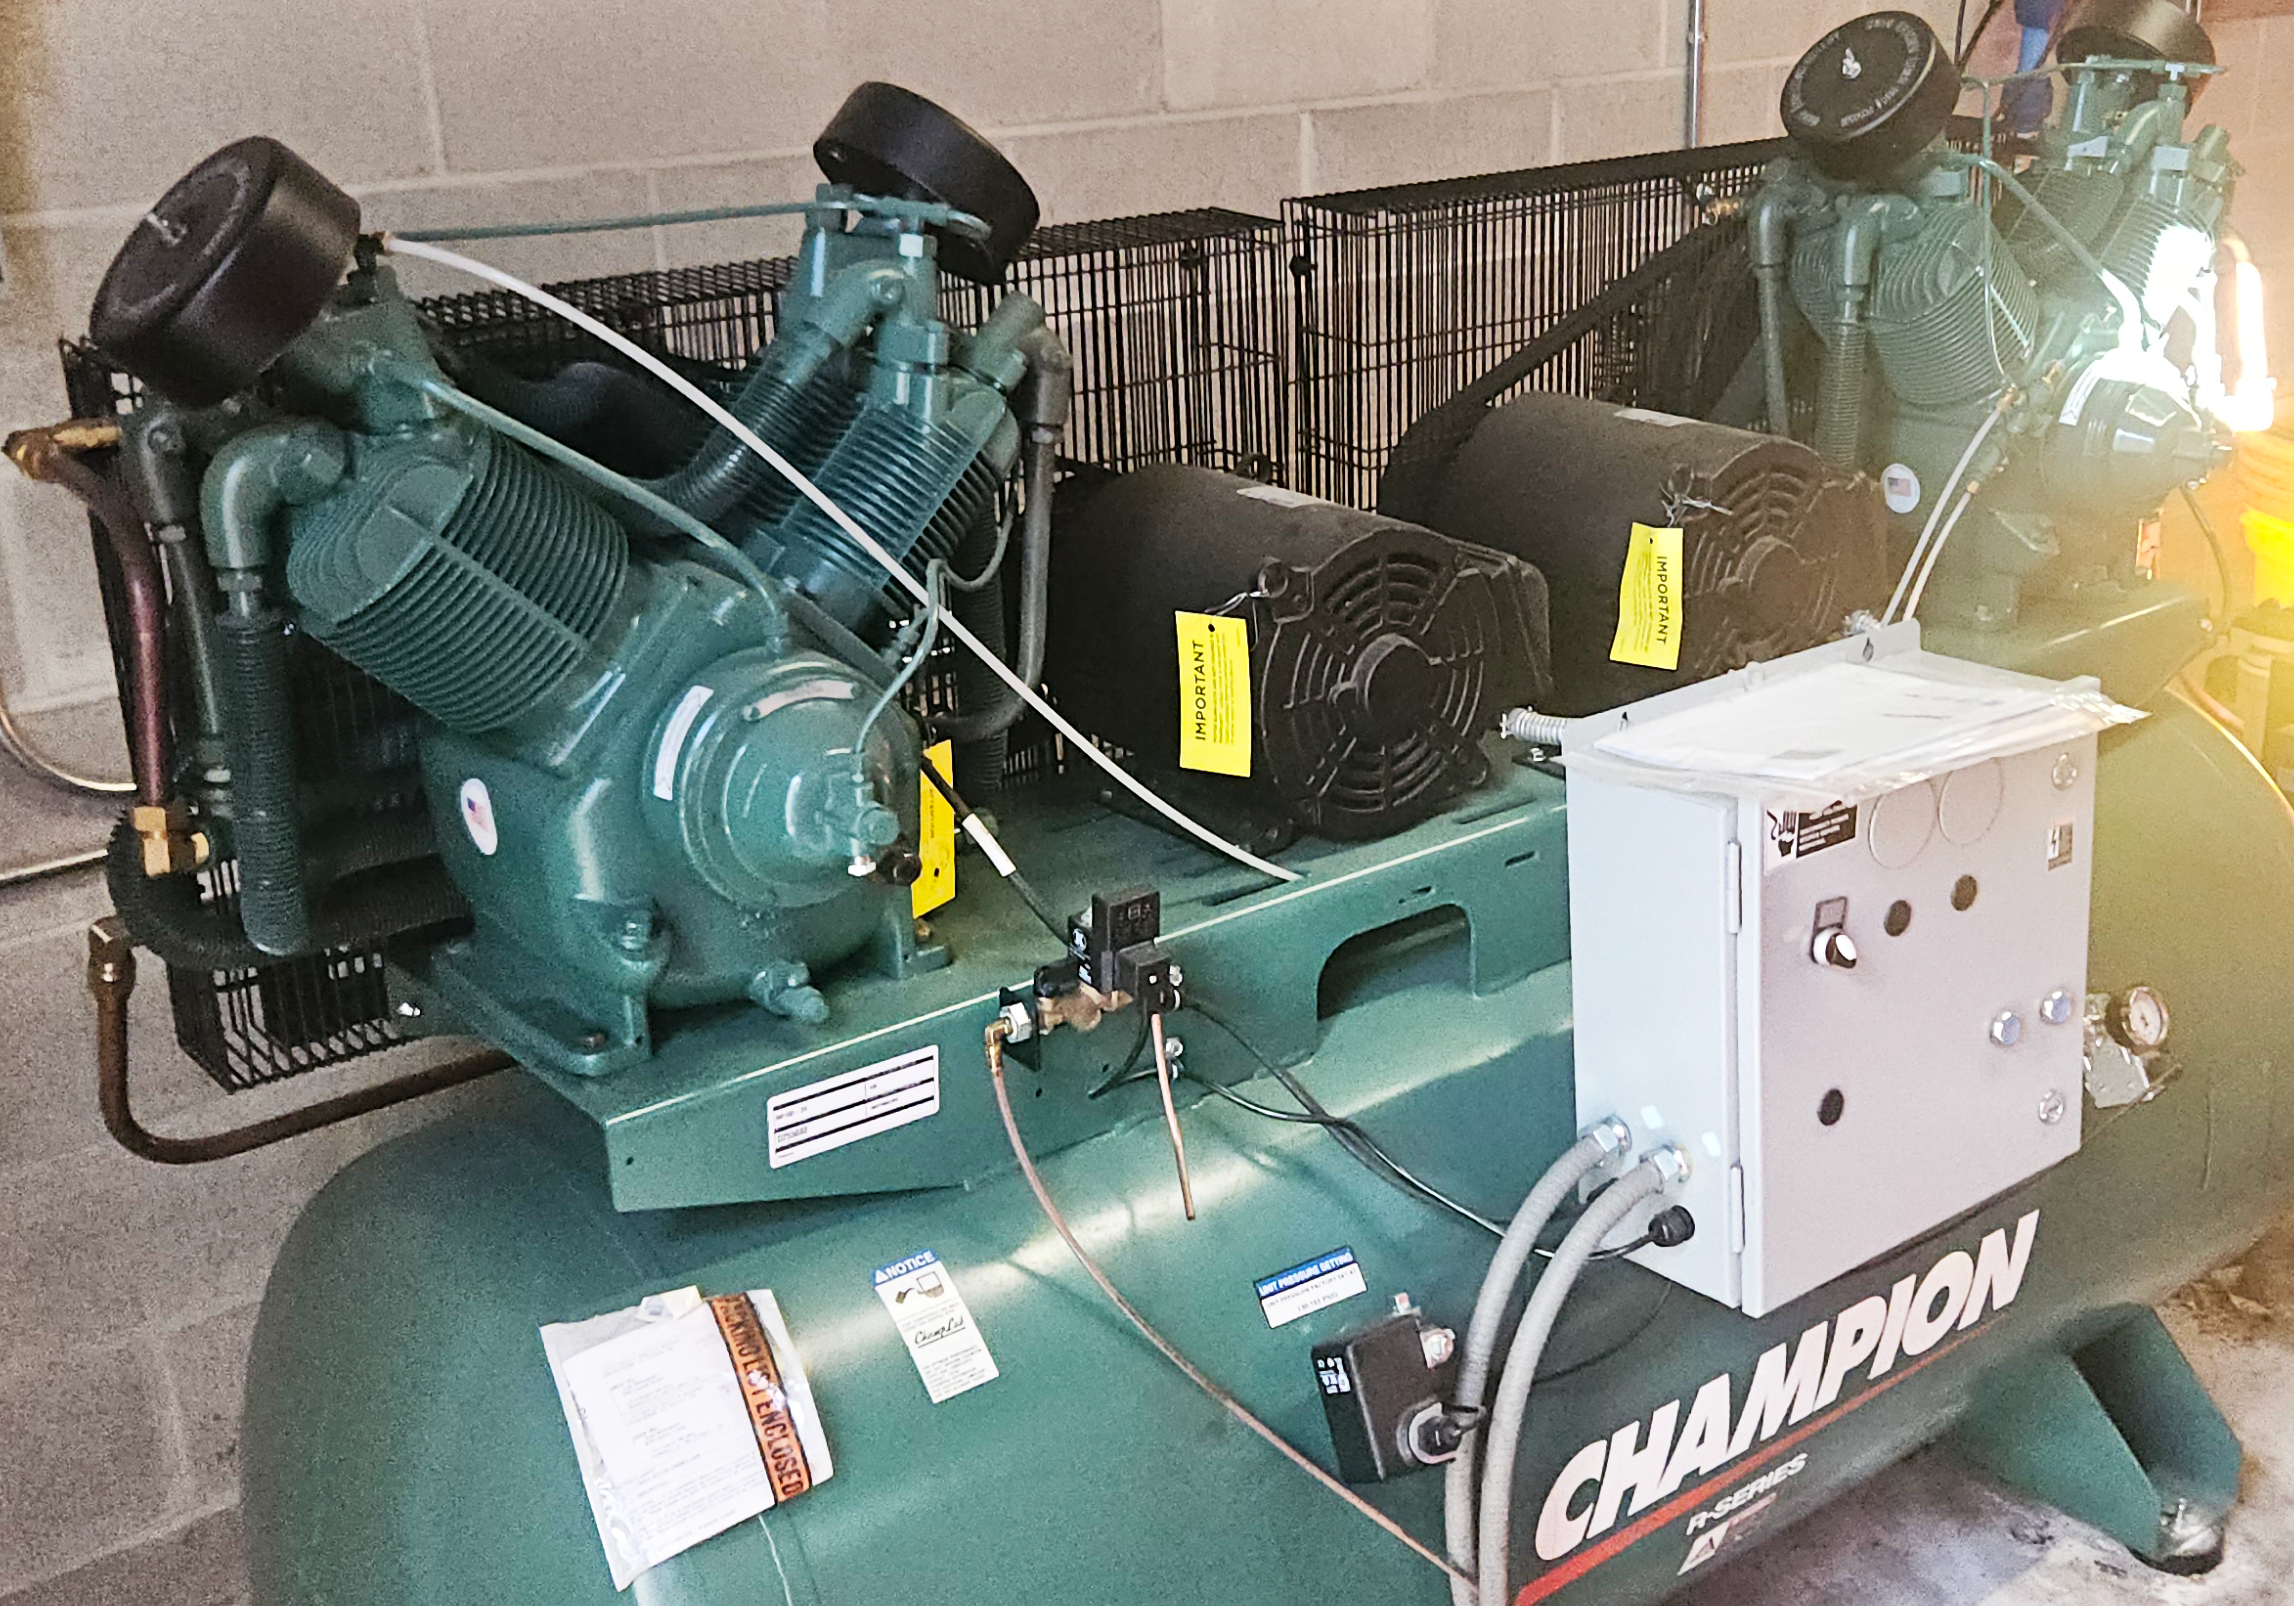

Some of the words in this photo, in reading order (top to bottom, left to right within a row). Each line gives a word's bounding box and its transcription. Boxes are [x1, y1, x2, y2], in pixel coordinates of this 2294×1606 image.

[1656, 555, 1670, 646] IMPORTANT
[1192, 639, 1207, 741] IMPORTANT
[884, 1251, 936, 1279] NOTICE
[1535, 1209, 2039, 1561] CHAMPION
[755, 1398, 805, 1498] ENCLOSED
[1685, 1452, 1809, 1536] R-SERIES
